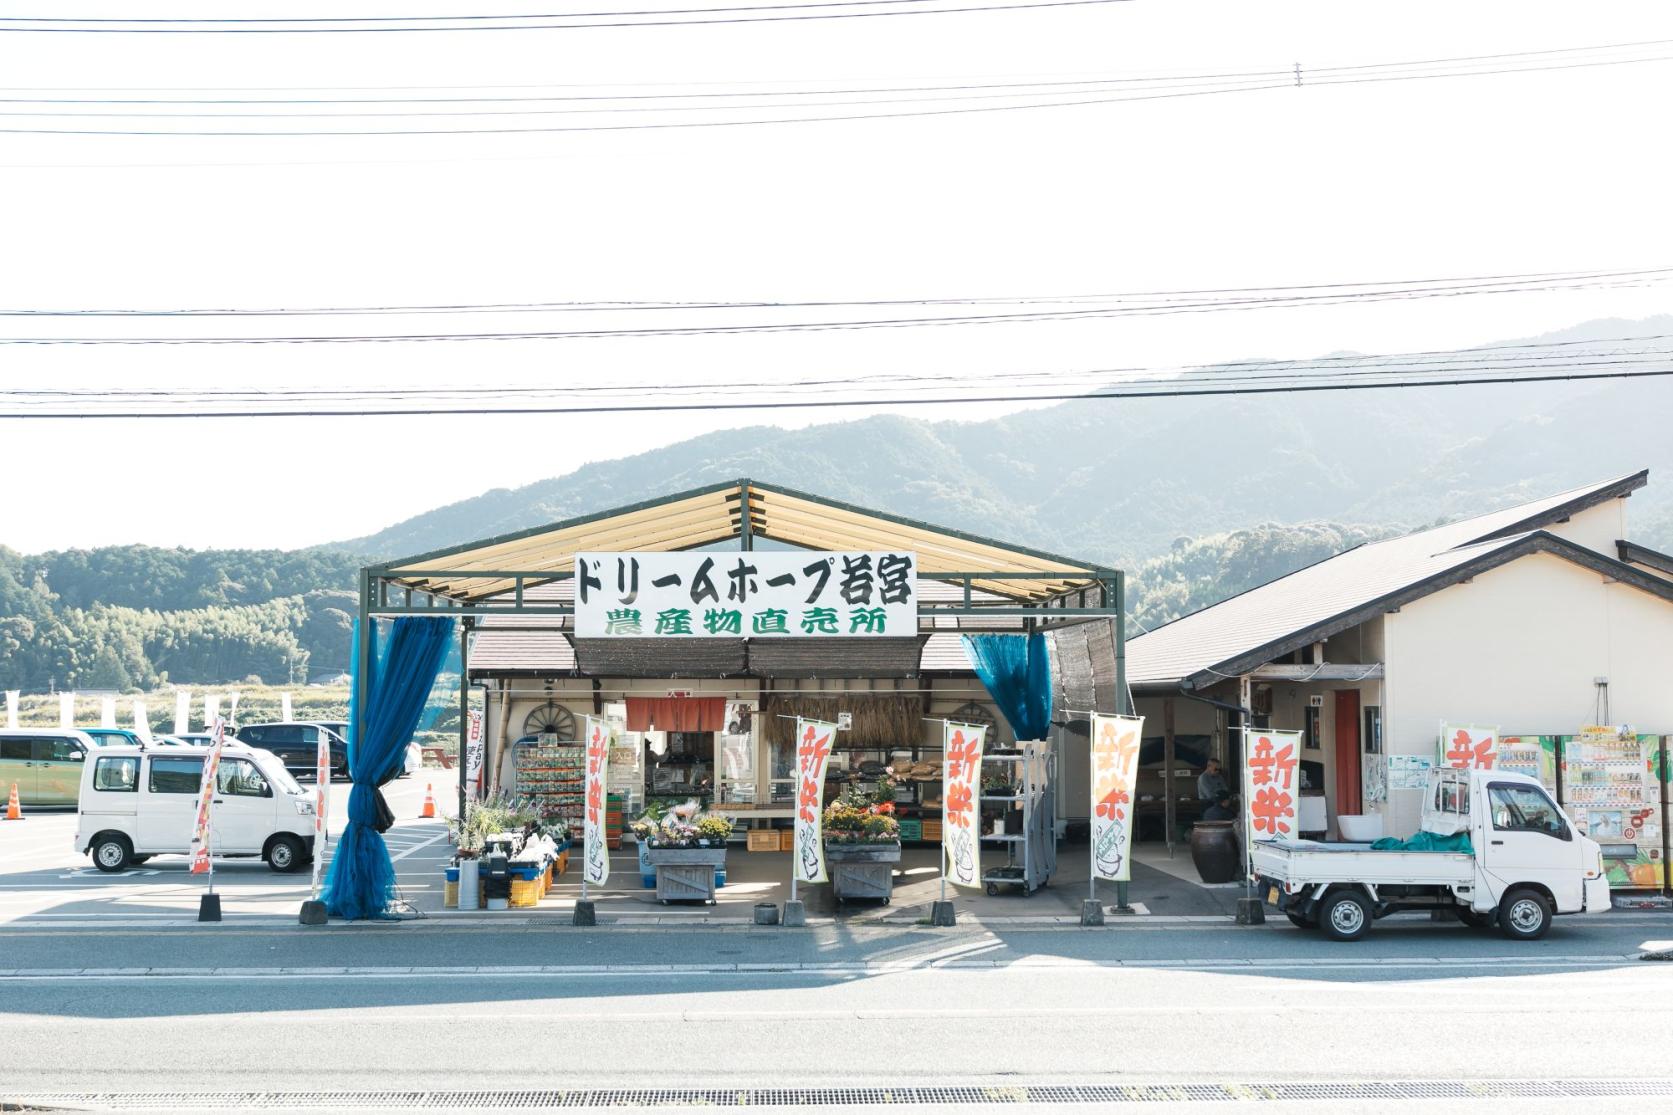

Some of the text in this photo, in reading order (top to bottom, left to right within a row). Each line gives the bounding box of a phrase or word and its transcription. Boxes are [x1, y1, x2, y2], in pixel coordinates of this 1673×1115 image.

[579, 554, 912, 605] ドリームホープ若宮
[605, 607, 888, 635] 農産物直売所
[799, 726, 830, 823] 新米
[947, 730, 981, 829] 新米
[1095, 723, 1138, 821] 新米
[1248, 736, 1297, 835] 新米
